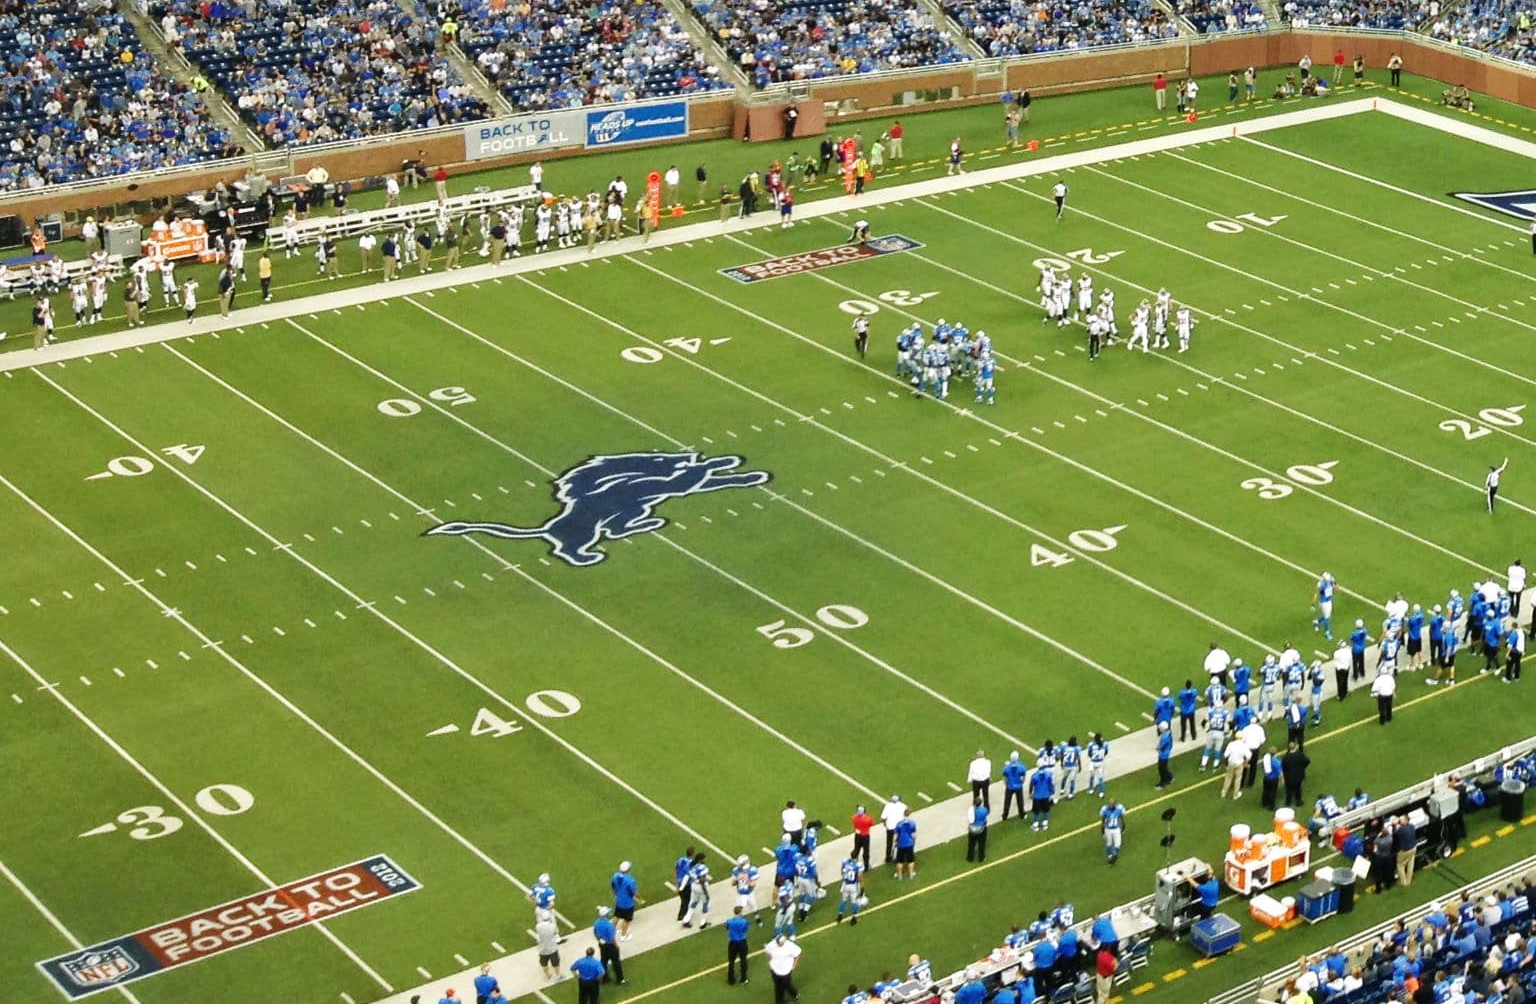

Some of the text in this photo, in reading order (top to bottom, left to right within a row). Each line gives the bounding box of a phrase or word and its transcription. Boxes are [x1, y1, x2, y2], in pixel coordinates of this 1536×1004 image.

[480, 119, 550, 139] BACK TO
[590, 121, 621, 134] HEADS
[1206, 211, 1279, 234] 10
[743, 255, 811, 275] BACK
[826, 246, 859, 259] TO
[757, 252, 873, 279] FOOTBALL
[1032, 248, 1108, 273] 20
[838, 290, 923, 315] 30
[621, 335, 702, 363] 40
[377, 386, 477, 418] 50
[1439, 406, 1525, 440] 20
[107, 443, 206, 477] 40
[1240, 464, 1334, 500] 30
[1031, 529, 1118, 568] 40
[756, 604, 869, 649] 50
[469, 690, 582, 738] 40
[117, 784, 254, 840] 30
[151, 871, 362, 949] BACK TO
[164, 888, 378, 963] FOOTBALL
[79, 960, 129, 984] NFL
